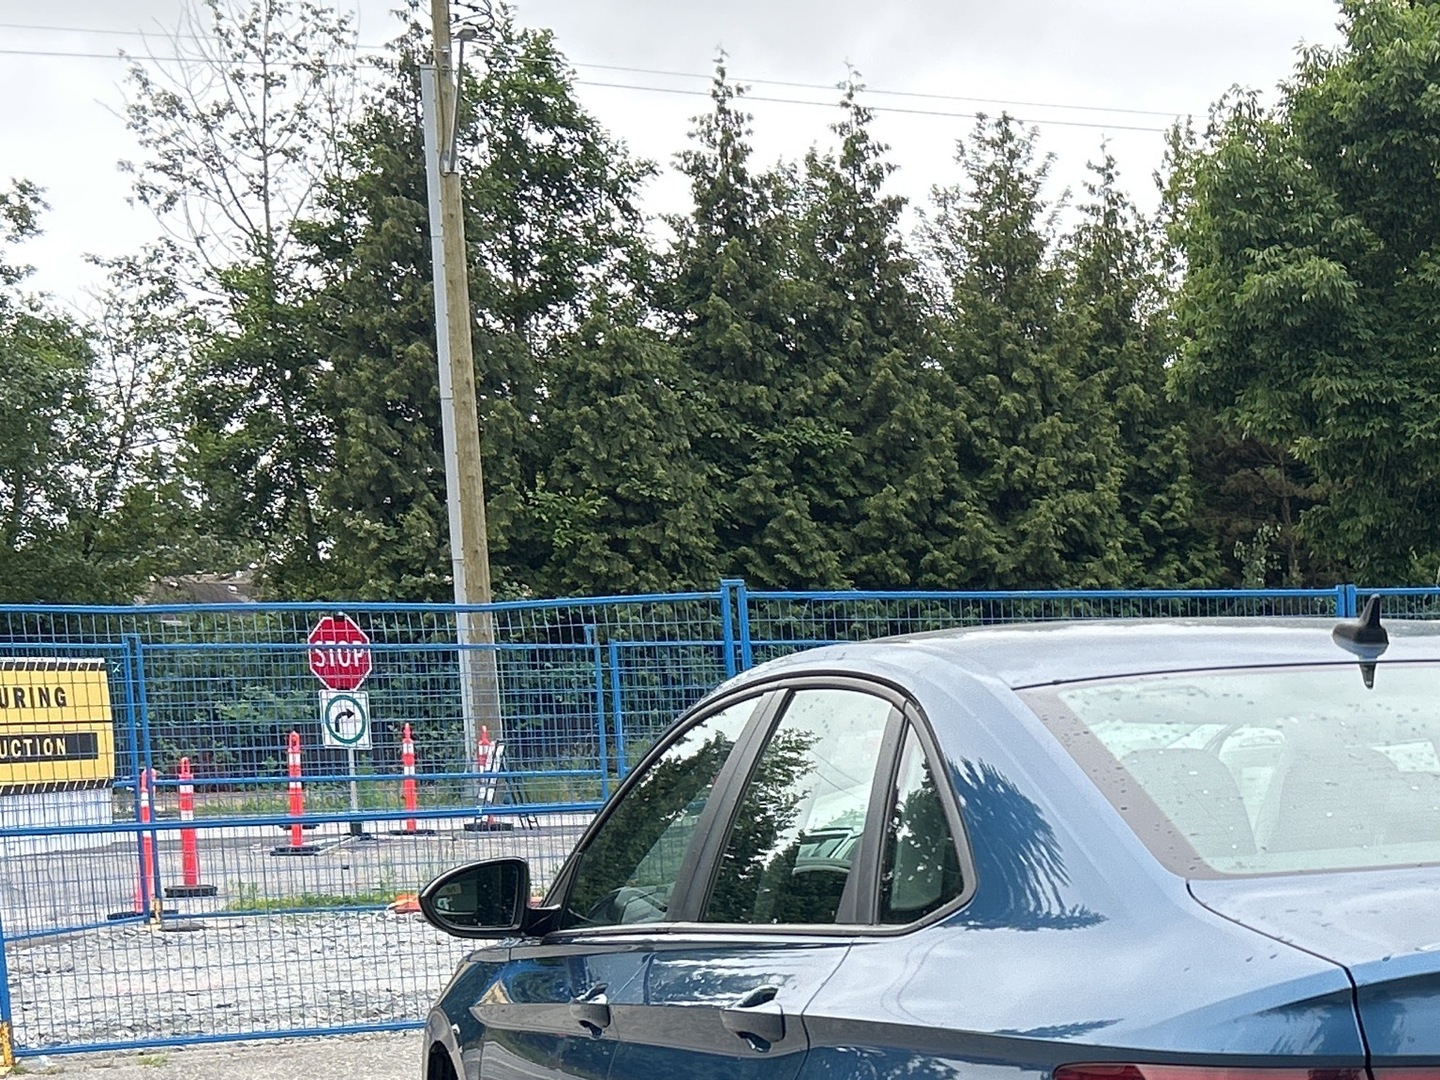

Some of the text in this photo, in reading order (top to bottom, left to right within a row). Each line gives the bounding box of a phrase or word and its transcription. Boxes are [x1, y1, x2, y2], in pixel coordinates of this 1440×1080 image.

[314, 640, 365, 668] STOP
[0, 686, 67, 709] URING
[0, 737, 66, 759] UCTION
